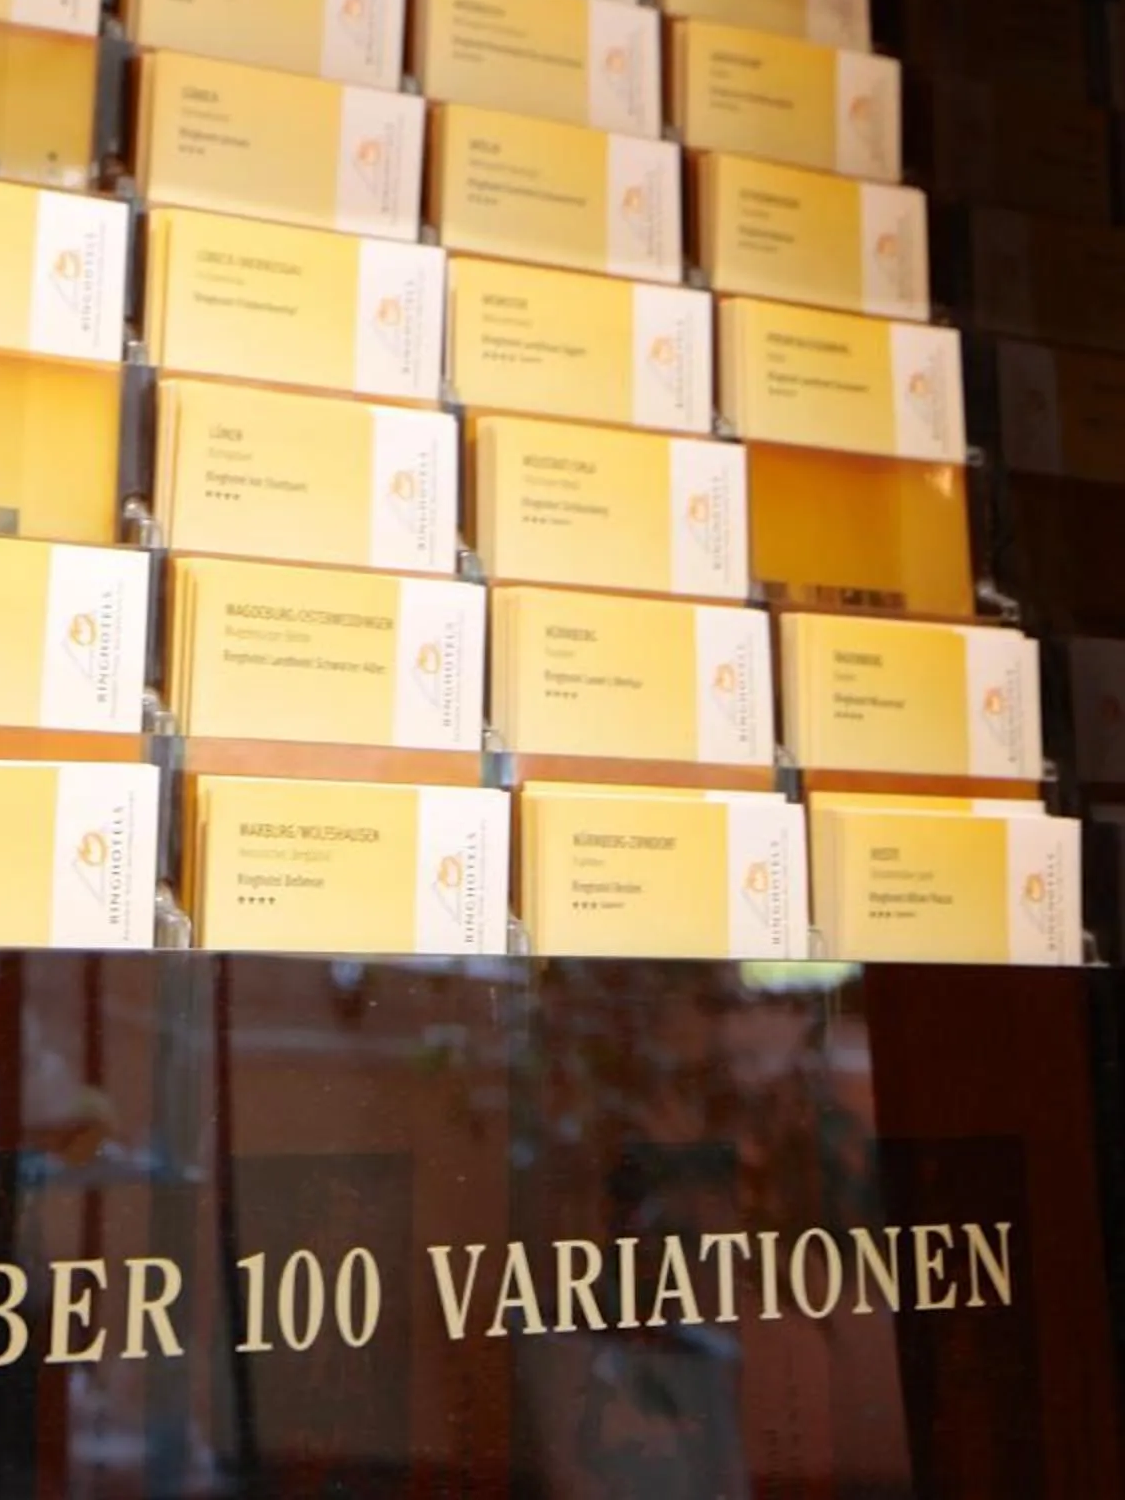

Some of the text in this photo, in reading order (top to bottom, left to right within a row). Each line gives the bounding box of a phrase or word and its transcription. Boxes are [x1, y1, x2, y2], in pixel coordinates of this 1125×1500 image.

[96, 588, 113, 704] RINGHOTELS
[109, 804, 126, 926] RINGHOTELS
[235, 1245, 382, 1354] 100
[428, 1218, 1015, 1343] VARIATIONEN
